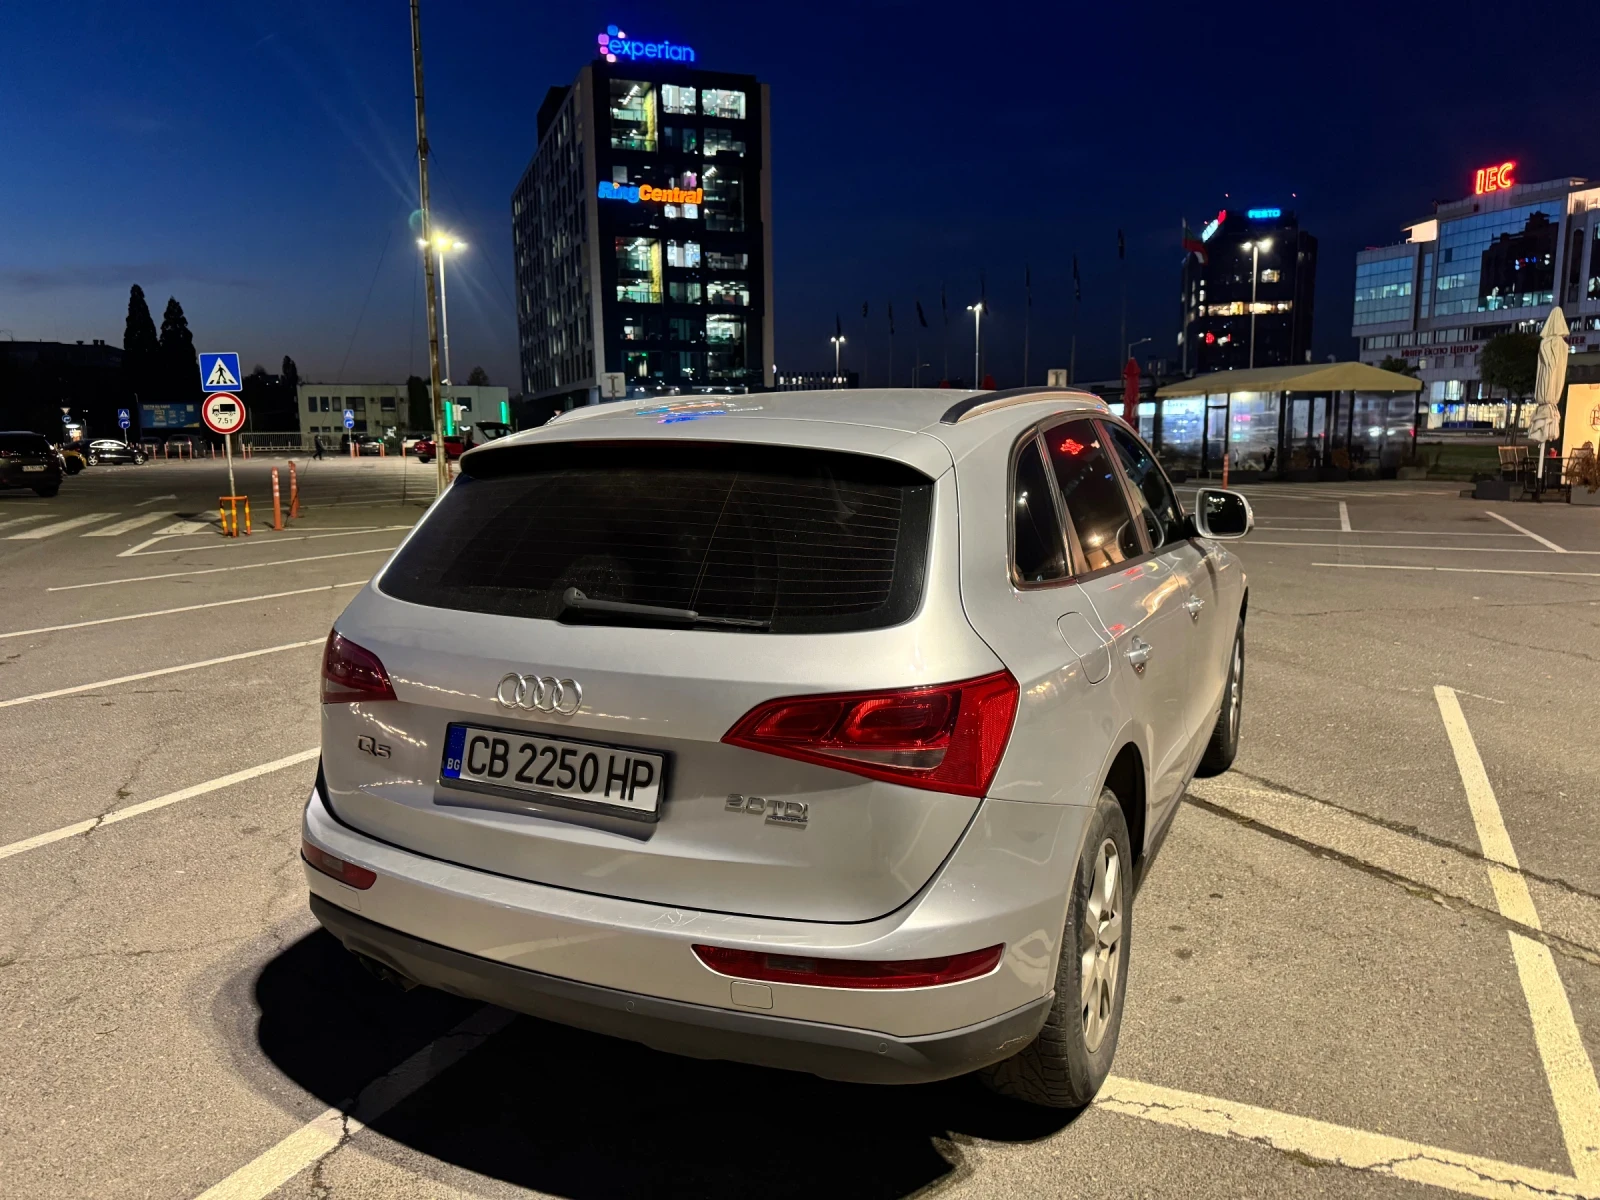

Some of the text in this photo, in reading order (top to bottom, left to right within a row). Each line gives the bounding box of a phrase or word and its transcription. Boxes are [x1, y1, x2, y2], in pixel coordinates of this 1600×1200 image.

[609, 39, 695, 62] experian
[1475, 161, 1515, 195] IEC
[598, 181, 703, 204] RingCentral
[1248, 209, 1281, 219] FESTO
[358, 734, 392, 759] Q5
[446, 758, 461, 771] BG
[467, 735, 654, 802] CB 2250 HP
[725, 793, 809, 819] 2.0 TDI
